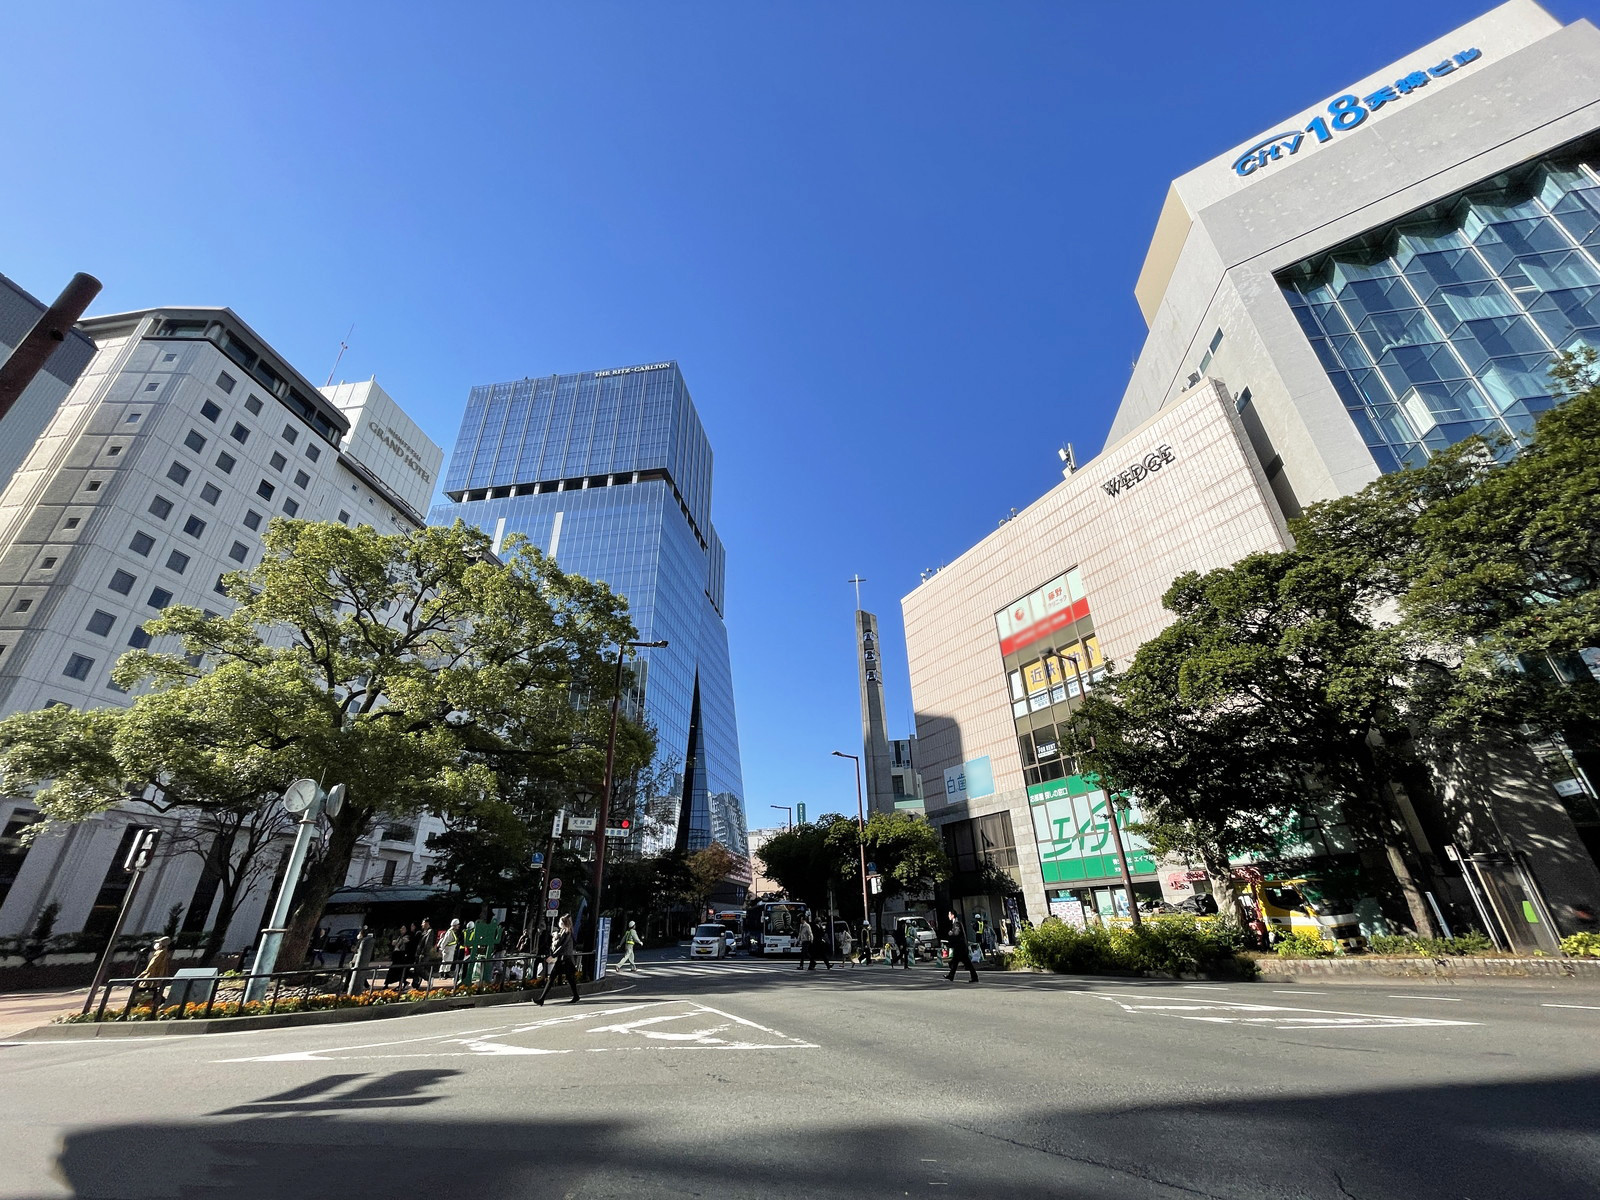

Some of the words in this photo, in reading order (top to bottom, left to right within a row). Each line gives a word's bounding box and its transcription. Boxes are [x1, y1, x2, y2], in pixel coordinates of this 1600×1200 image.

[1305, 94, 1369, 144] 18
[1362, 47, 1482, 112] 天神ビル
[369, 422, 404, 457] GRAND
[404, 454, 430, 484] HOTEL
[1100, 443, 1175, 498] WEDGE
